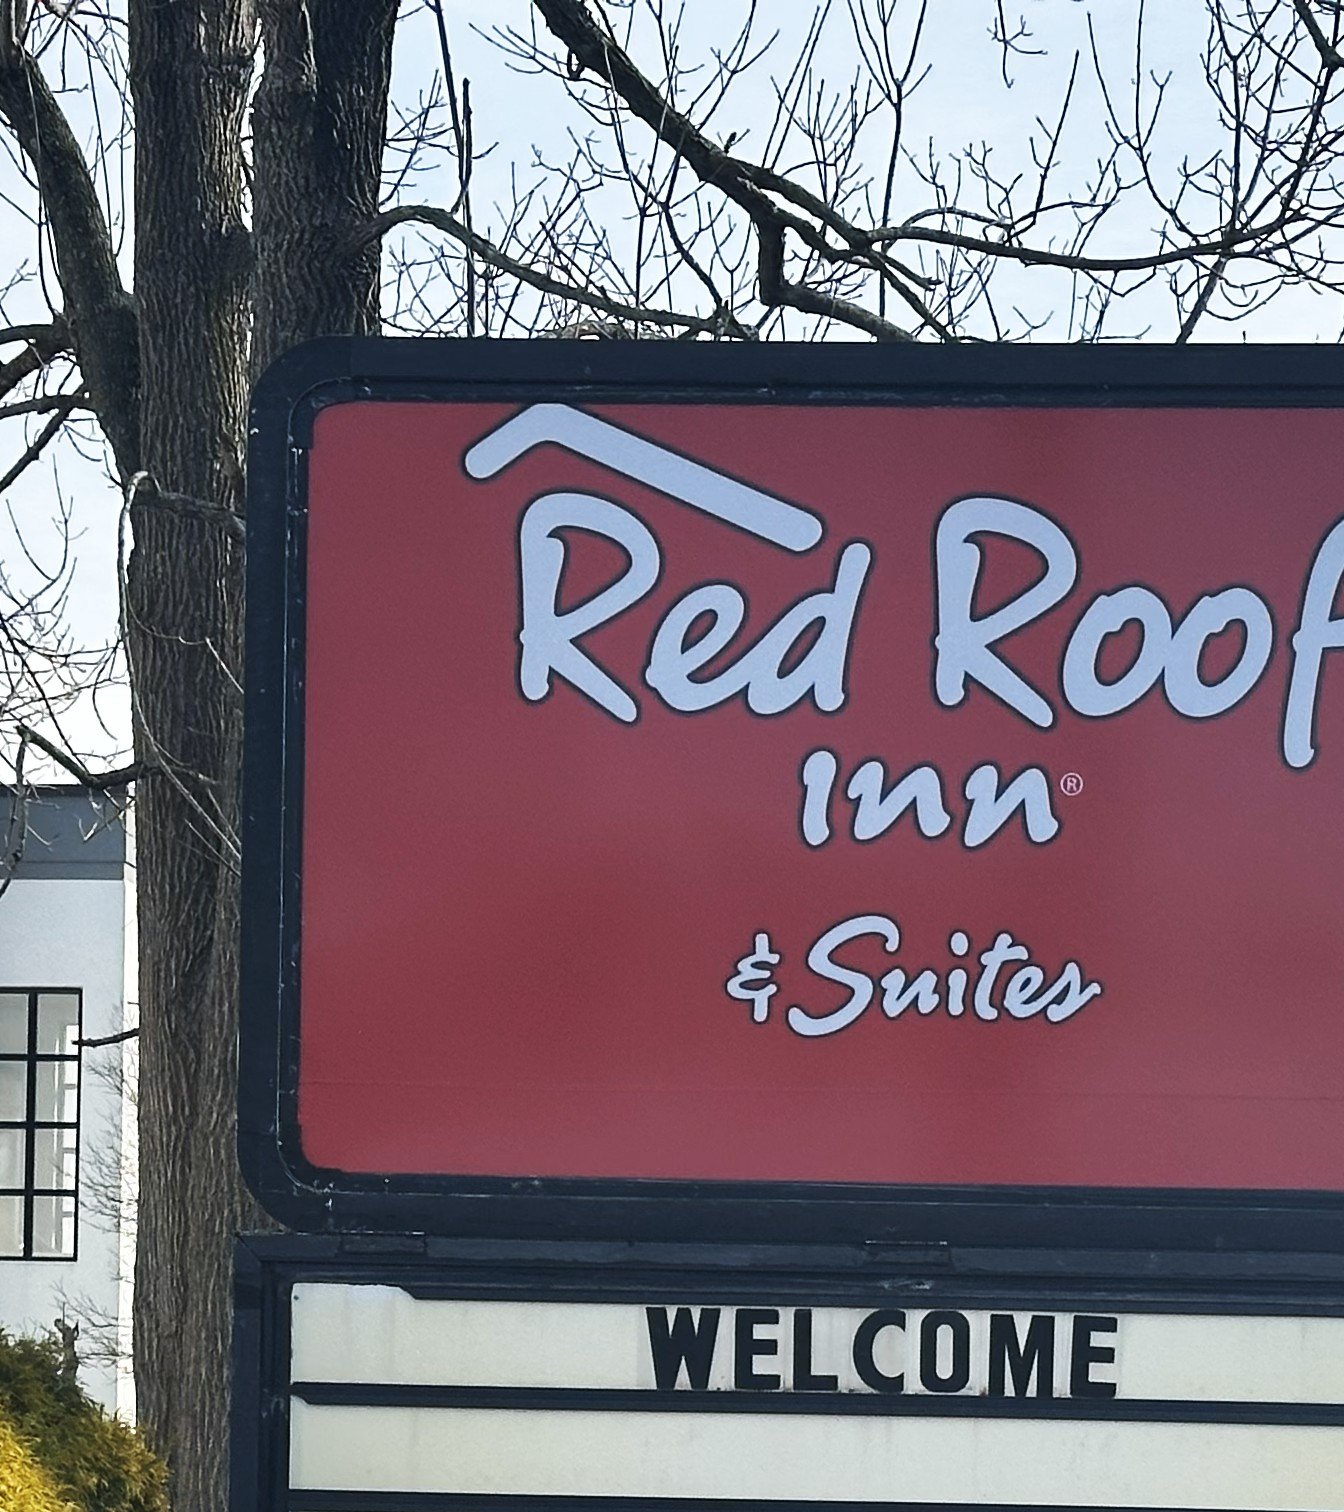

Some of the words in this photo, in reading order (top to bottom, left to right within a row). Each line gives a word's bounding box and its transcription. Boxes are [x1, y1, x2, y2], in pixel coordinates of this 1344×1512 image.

[518, 491, 872, 724] Red
[725, 932, 781, 1023] &
[788, 914, 1102, 1037] Suites
[645, 1306, 1119, 1399] WELCOME
